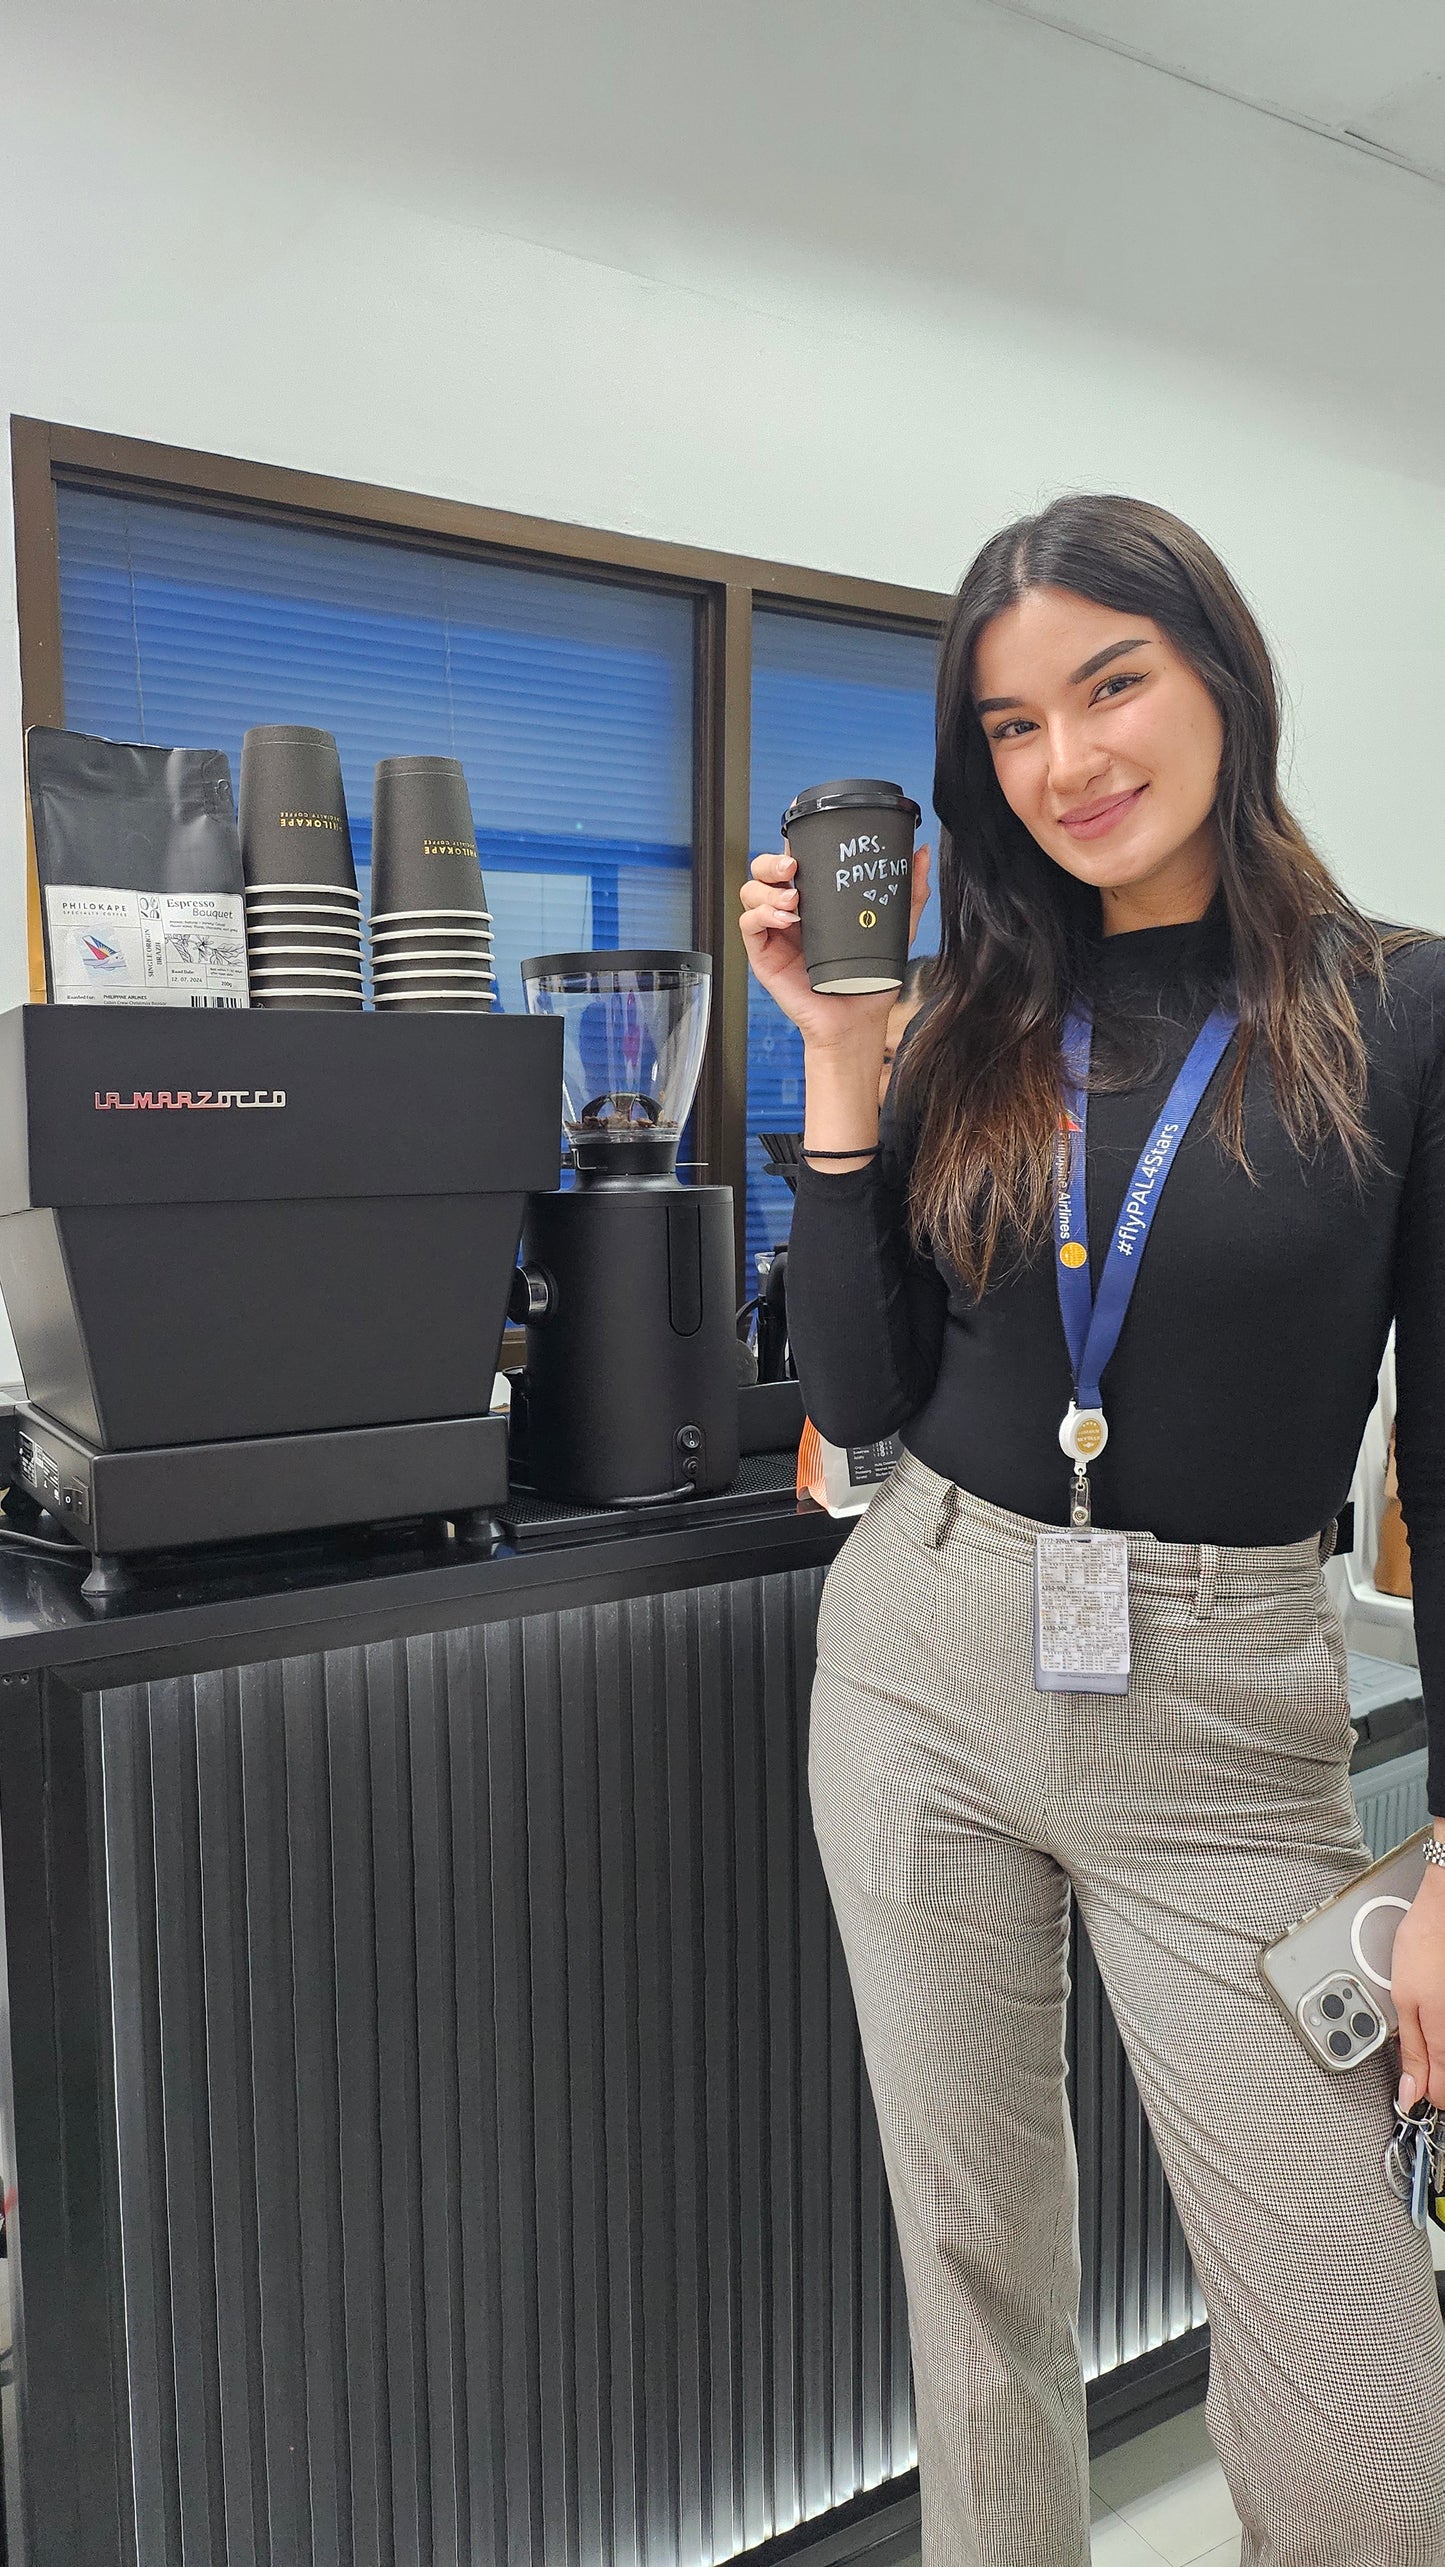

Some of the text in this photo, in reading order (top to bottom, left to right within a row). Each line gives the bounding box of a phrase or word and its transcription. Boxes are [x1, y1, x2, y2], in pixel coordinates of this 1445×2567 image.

[839, 835, 886, 862] MRS.
[835, 858, 908, 892] RAVENA
[62, 902, 127, 912] PHILOKAPE
[166, 898, 215, 909] Espresso
[192, 908, 233, 919] Bouquet
[144, 928, 154, 978] SINGLE ORIGIN
[94, 1091, 286, 1110] LA MARZOCCO
[1117, 1123, 1179, 1257] #flyPAL4Stars
[1058, 1190, 1073, 1240] Airlines
